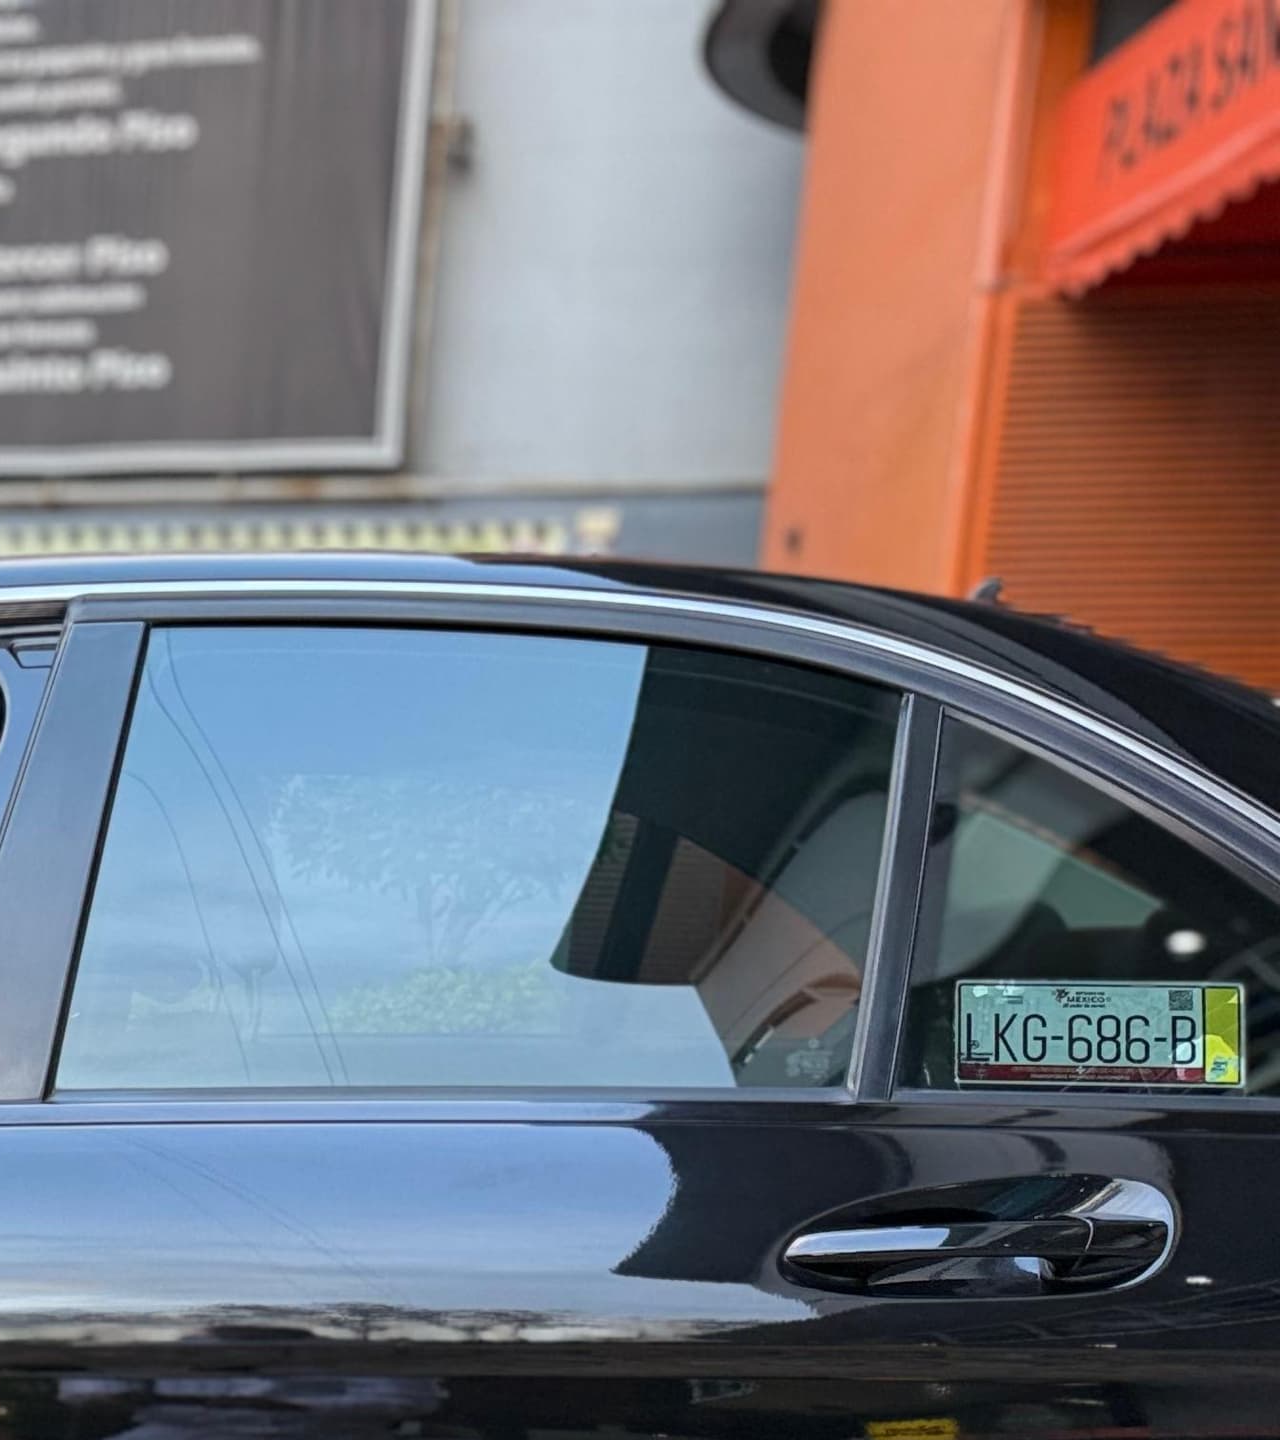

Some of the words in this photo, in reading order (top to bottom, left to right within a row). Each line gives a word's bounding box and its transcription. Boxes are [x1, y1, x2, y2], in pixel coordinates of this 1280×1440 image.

[1097, 36, 1205, 180] PLAZA
[120, 112, 197, 150] Piso
[85, 236, 168, 276] Piso
[89, 352, 171, 391] Piso
[964, 1012, 1197, 1065] LKG-686-B
